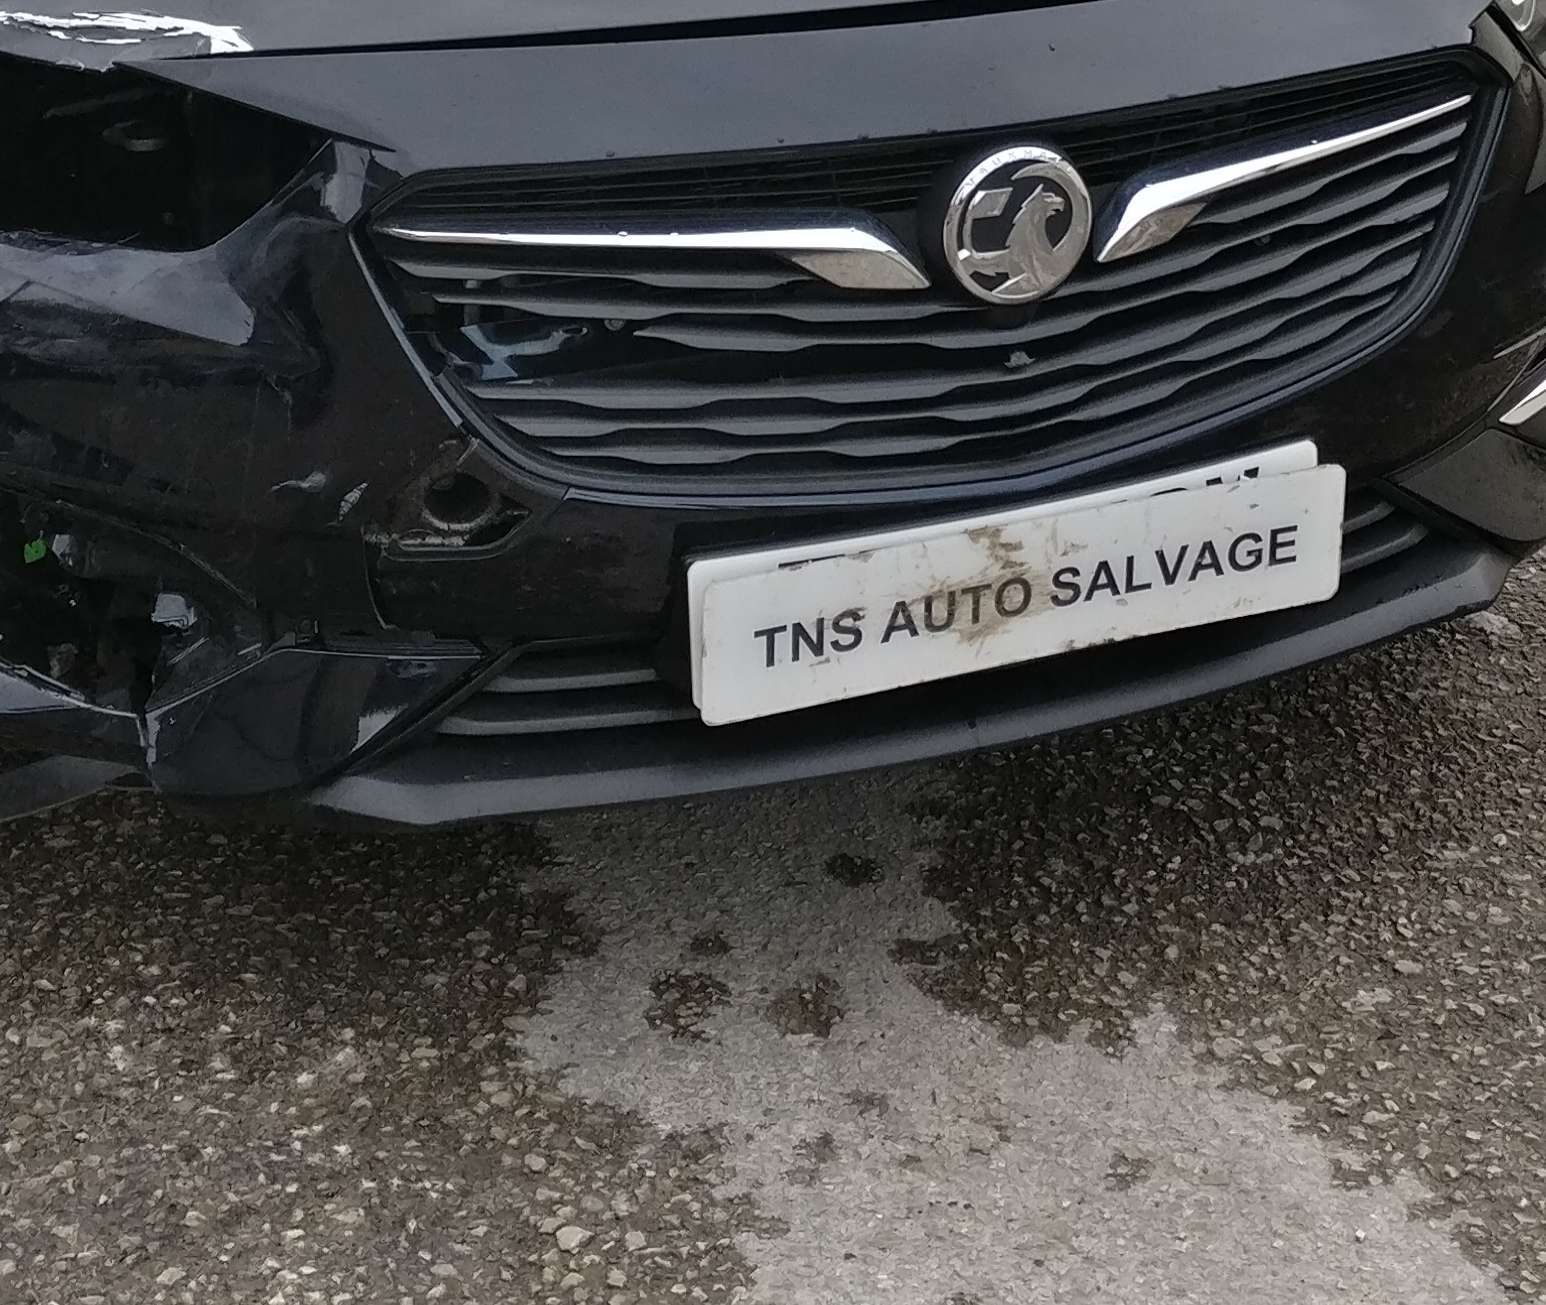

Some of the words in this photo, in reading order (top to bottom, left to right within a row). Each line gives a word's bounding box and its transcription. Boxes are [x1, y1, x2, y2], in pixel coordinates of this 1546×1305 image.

[753, 606, 867, 668] TNS
[880, 576, 1032, 643] AUTO
[1051, 524, 1299, 607] SALVAGE
